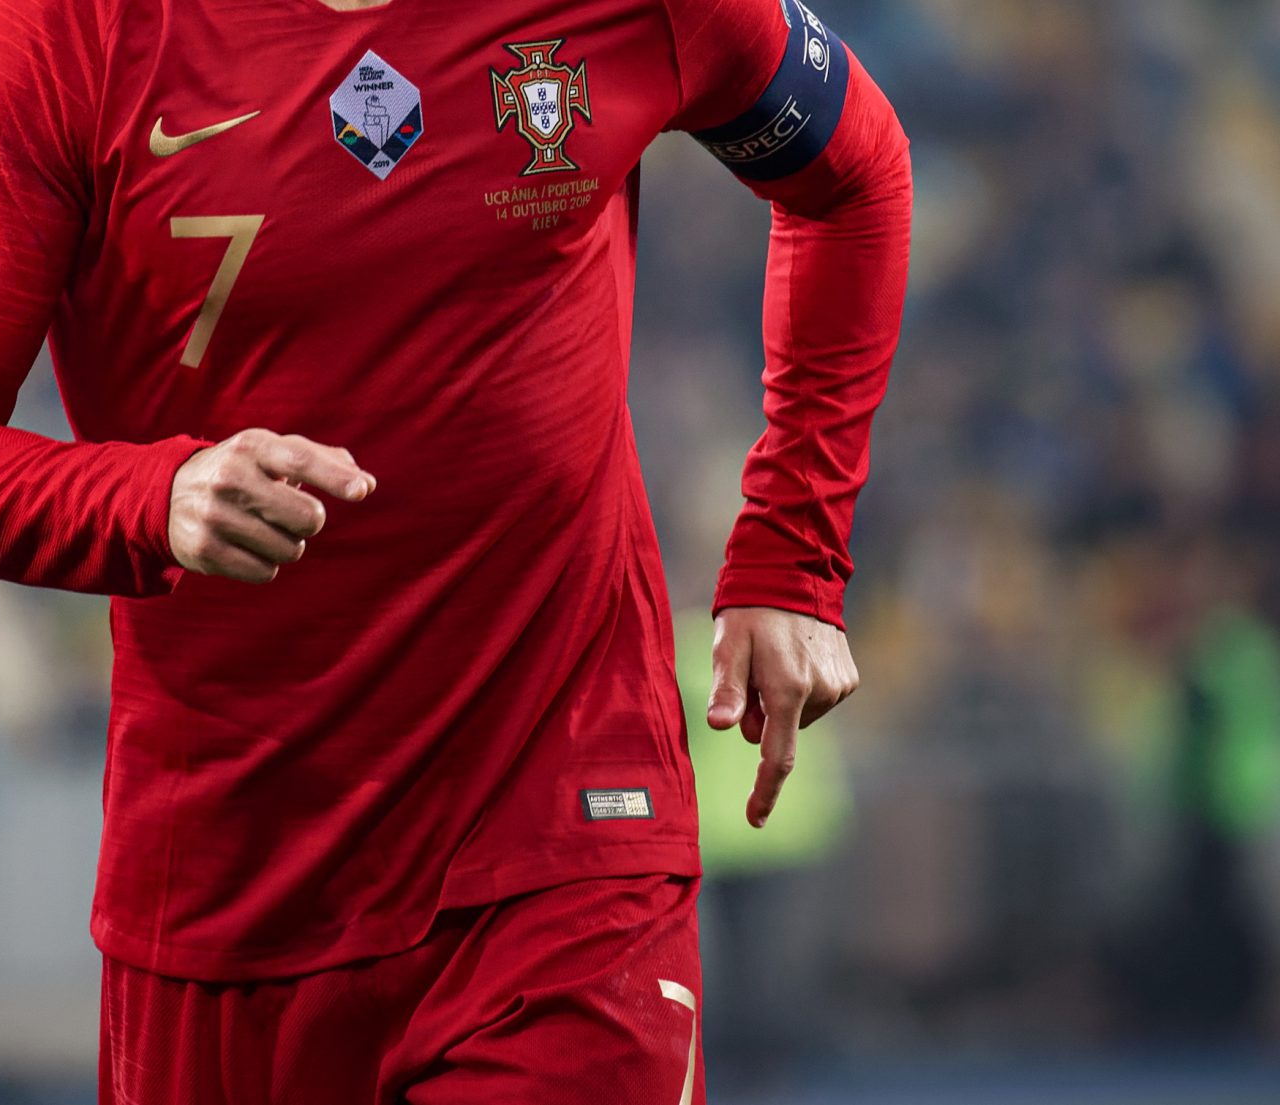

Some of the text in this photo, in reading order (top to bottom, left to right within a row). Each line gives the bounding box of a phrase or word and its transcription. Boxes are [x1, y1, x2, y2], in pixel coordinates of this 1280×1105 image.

[353, 81, 394, 92] WINNER
[707, 101, 802, 158] ESPECT
[372, 160, 390, 168] 2019
[484, 185, 539, 206] UCRÂNIA
[548, 177, 599, 198] PORTUGAL
[496, 194, 592, 221] 14 OUTUBRO 2019
[532, 214, 560, 231] KIEV
[170, 214, 266, 369] 7
[658, 979, 696, 1105] 7
